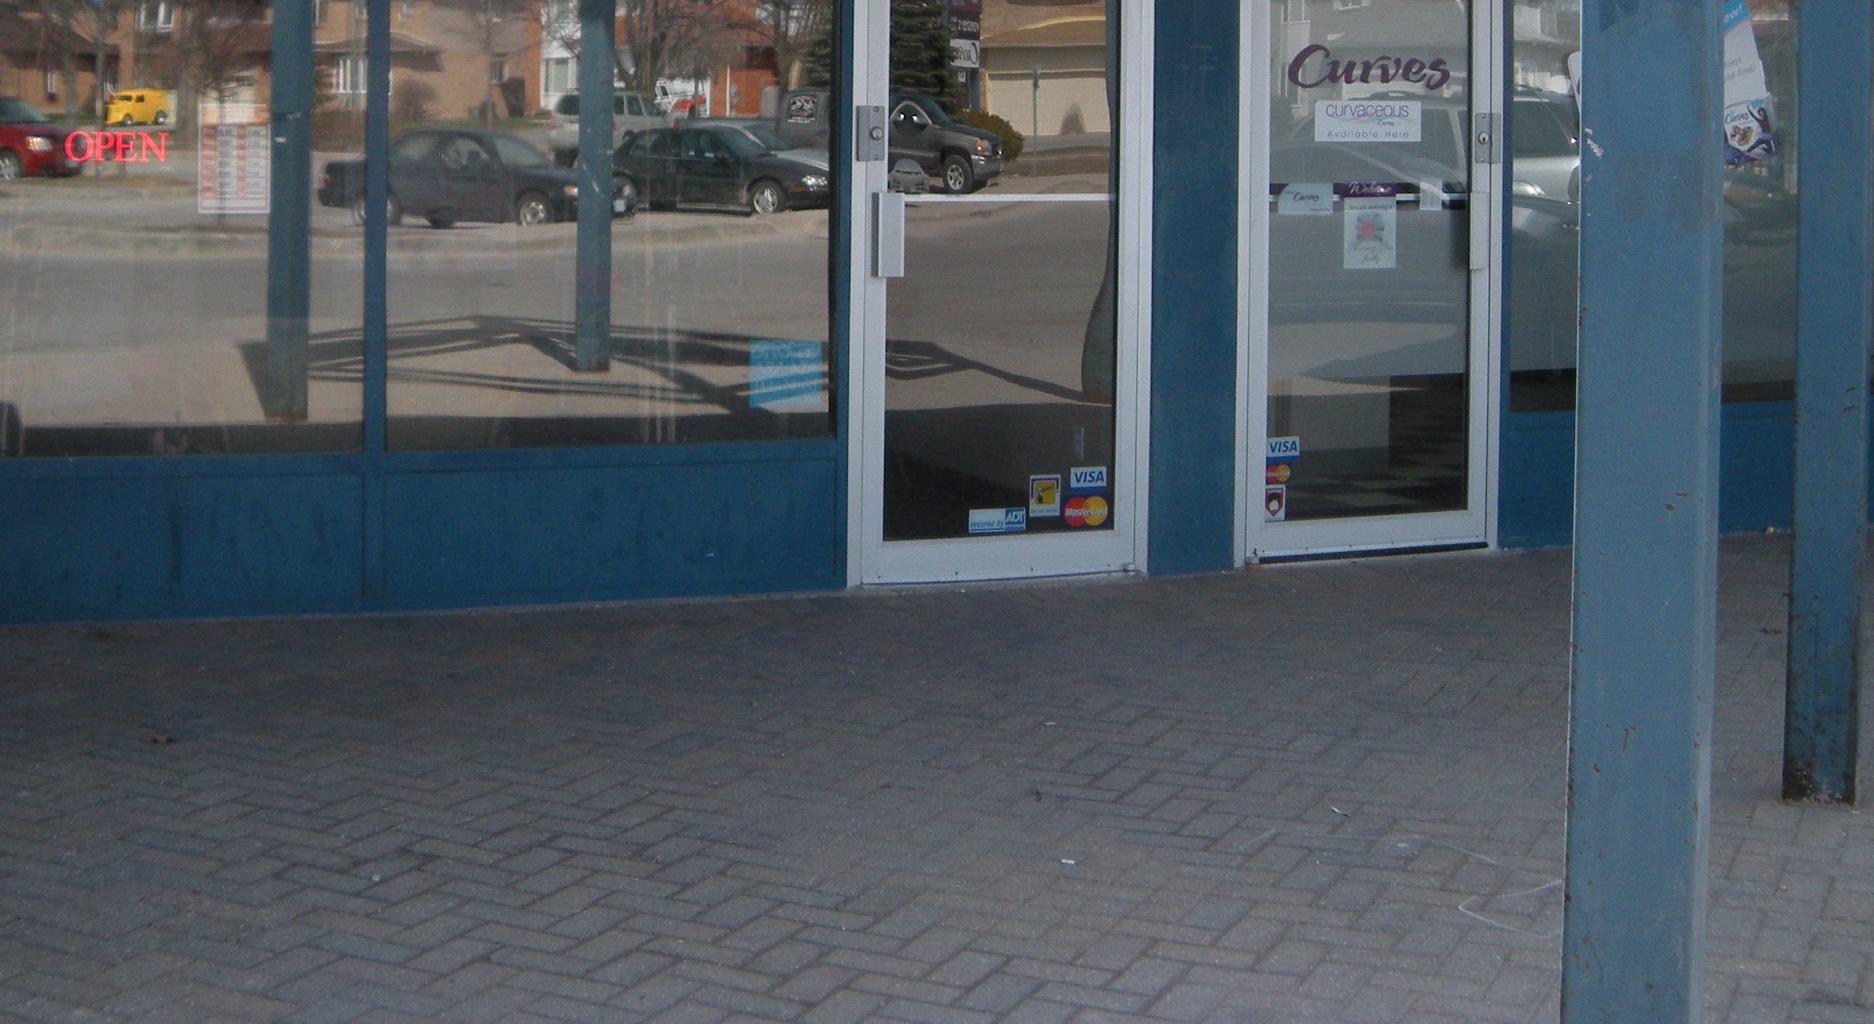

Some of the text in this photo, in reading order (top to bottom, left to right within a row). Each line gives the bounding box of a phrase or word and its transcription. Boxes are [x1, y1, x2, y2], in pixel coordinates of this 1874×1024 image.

[1724, 4, 1743, 23] ew!
[1287, 43, 1451, 90] Curves
[1325, 103, 1410, 118] curvaceous
[1327, 129, 1409, 138] Available Here
[64, 130, 170, 163] OPEN
[1269, 440, 1298, 454] VISA
[1074, 470, 1105, 484] VISA
